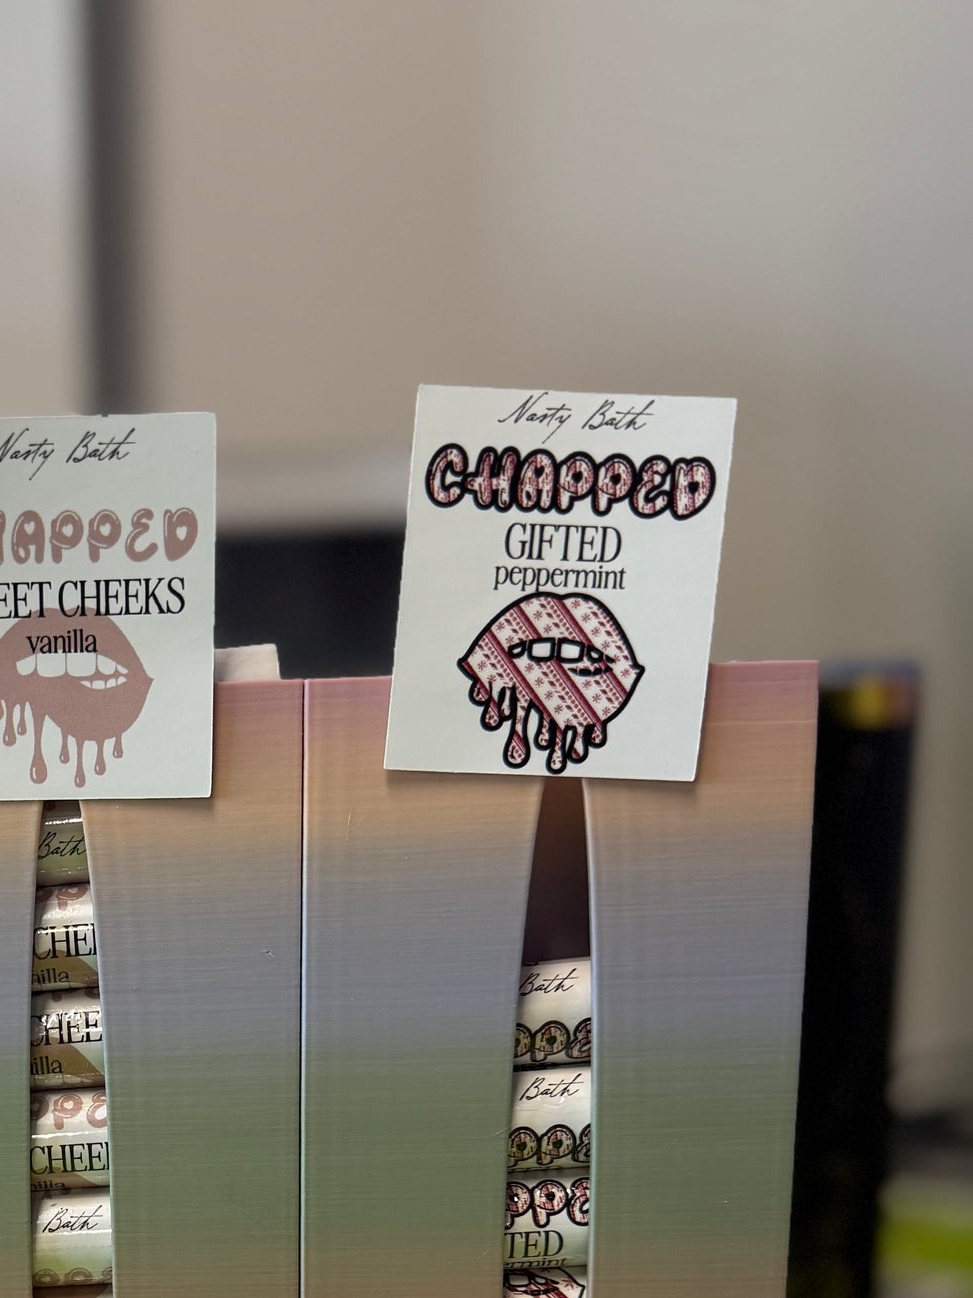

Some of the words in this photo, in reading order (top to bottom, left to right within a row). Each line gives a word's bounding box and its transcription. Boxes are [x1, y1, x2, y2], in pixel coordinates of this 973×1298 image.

[497, 392, 572, 444] Nasty
[581, 399, 656, 432] Bath
[66, 428, 137, 463] Bath
[425, 443, 717, 521] CHAPPED
[504, 523, 622, 563] GIFTED
[493, 564, 626, 592] peppermint
[58, 576, 186, 618] CHEEKS
[26, 629, 98, 654] vanilla
[519, 968, 579, 996] Bath
[30, 1010, 103, 1047] CHEE
[519, 1073, 584, 1101] Bath
[30, 1142, 109, 1175] CHEE
[42, 1204, 104, 1233] Bath
